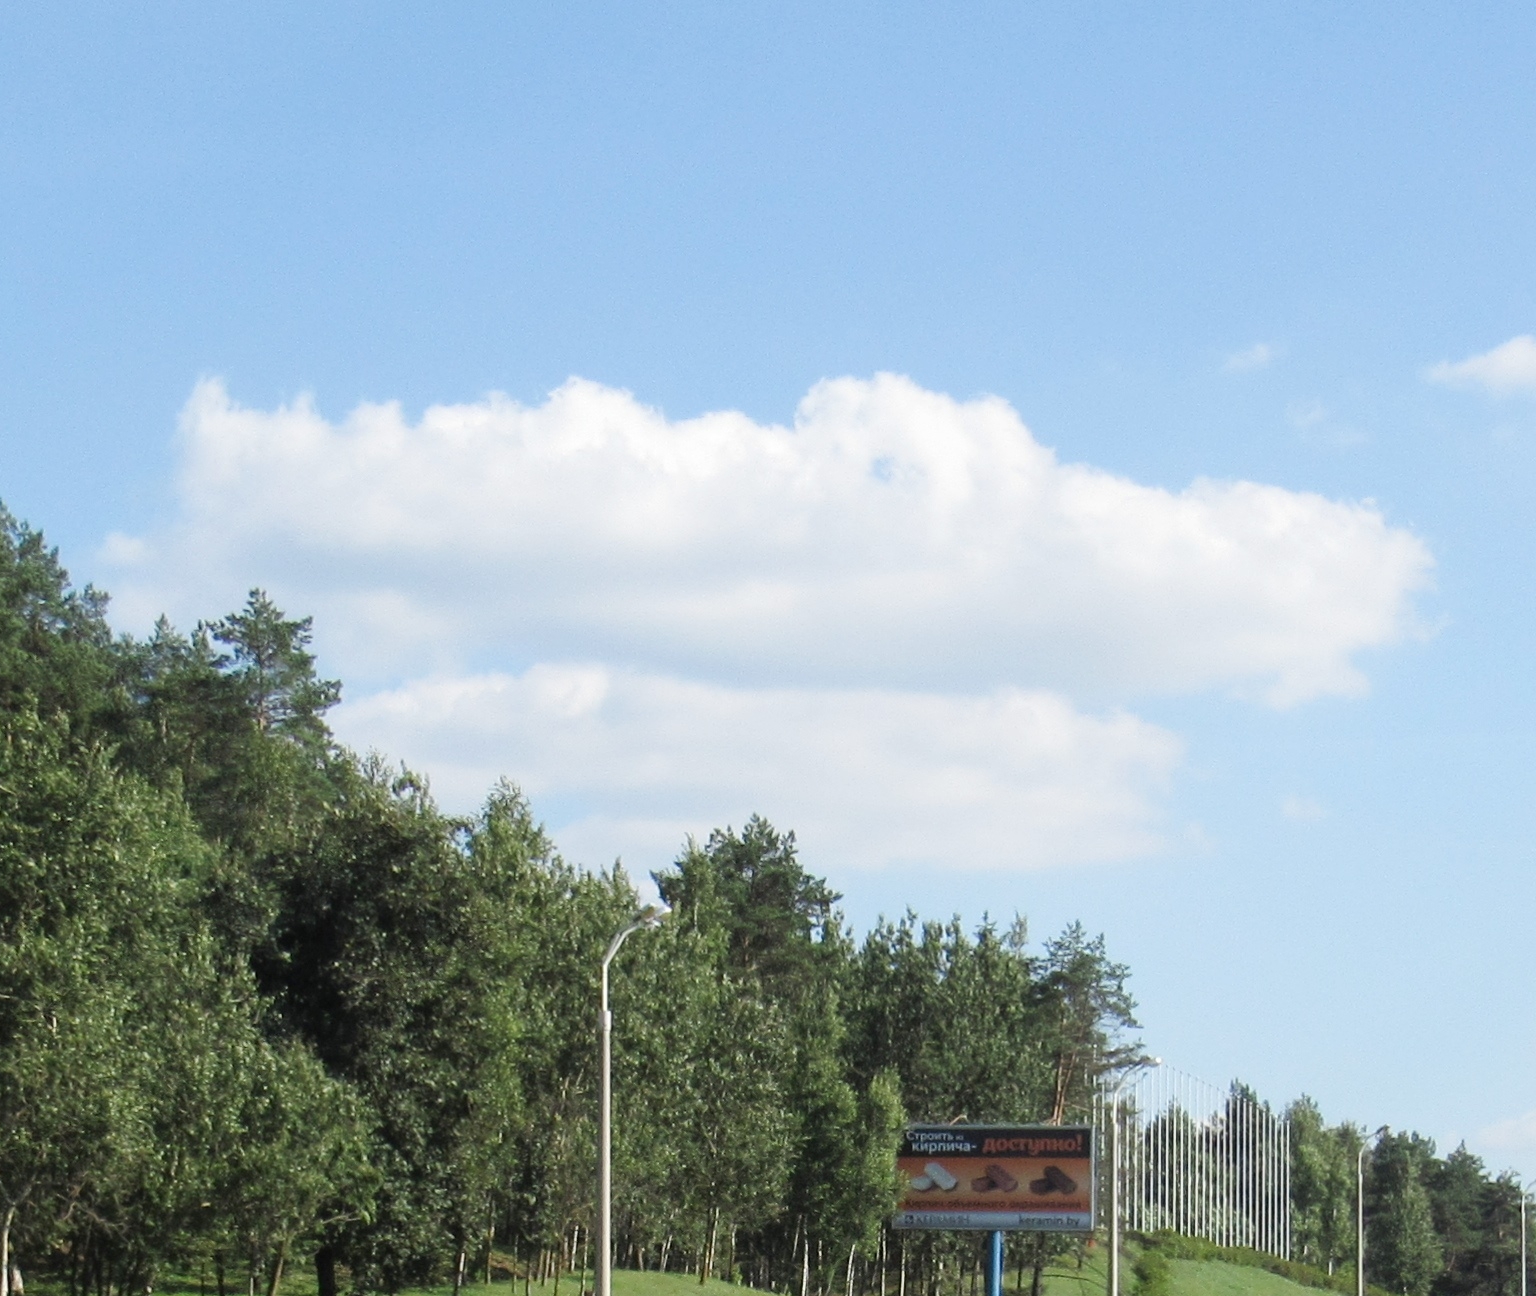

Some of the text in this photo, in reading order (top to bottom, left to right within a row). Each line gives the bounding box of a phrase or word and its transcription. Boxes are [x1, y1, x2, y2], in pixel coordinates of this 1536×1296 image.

[906, 1131, 953, 1142] Строить
[912, 1141, 977, 1155] кирпича-
[982, 1134, 1083, 1156] доступно!
